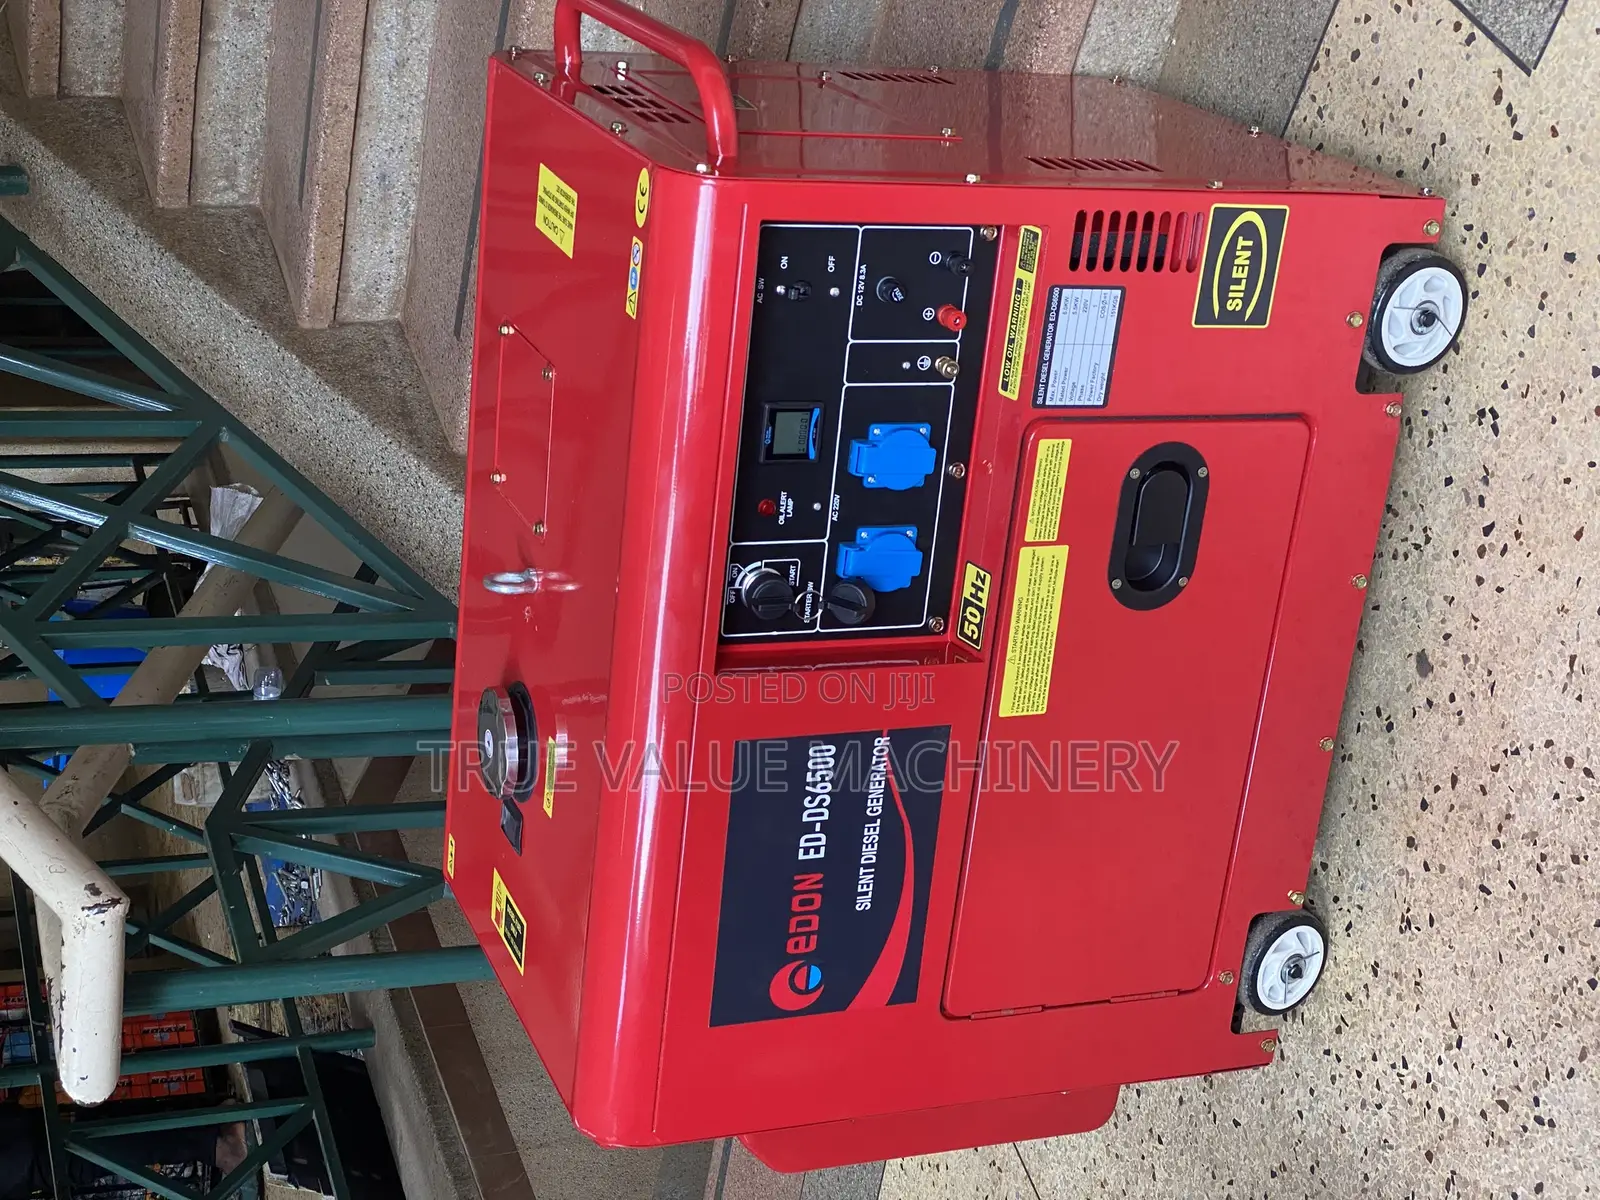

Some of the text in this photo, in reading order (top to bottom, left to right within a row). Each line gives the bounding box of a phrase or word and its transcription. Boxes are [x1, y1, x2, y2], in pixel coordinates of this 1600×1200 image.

[637, 182, 647, 214] CE
[780, 256, 789, 269] ON
[827, 255, 836, 272] OFF
[859, 264, 867, 280] 8.3A
[1226, 236, 1254, 312] SILENT
[756, 277, 765, 303] AC SW
[856, 295, 864, 306] DC
[1009, 294, 1021, 340] WARNING
[1006, 342, 1014, 358] OIL
[1036, 287, 1060, 404] SILENT DIESEL GENERATOR ED-DS6500
[1003, 359, 1011, 382] LOW
[1068, 382, 1077, 401] Voltage
[1077, 385, 1085, 401] Phase
[779, 491, 788, 514] ALERT
[786, 498, 795, 517] LAMP
[832, 511, 839, 521] AC
[731, 567, 738, 578] ON
[788, 565, 797, 586] START
[729, 590, 737, 603] OFF
[963, 570, 986, 640] 50 Hz
[803, 593, 813, 623] STARTER
[797, 745, 837, 860] ED-DS6500
[855, 736, 891, 911] SILENT DIESEL GENERATOR
